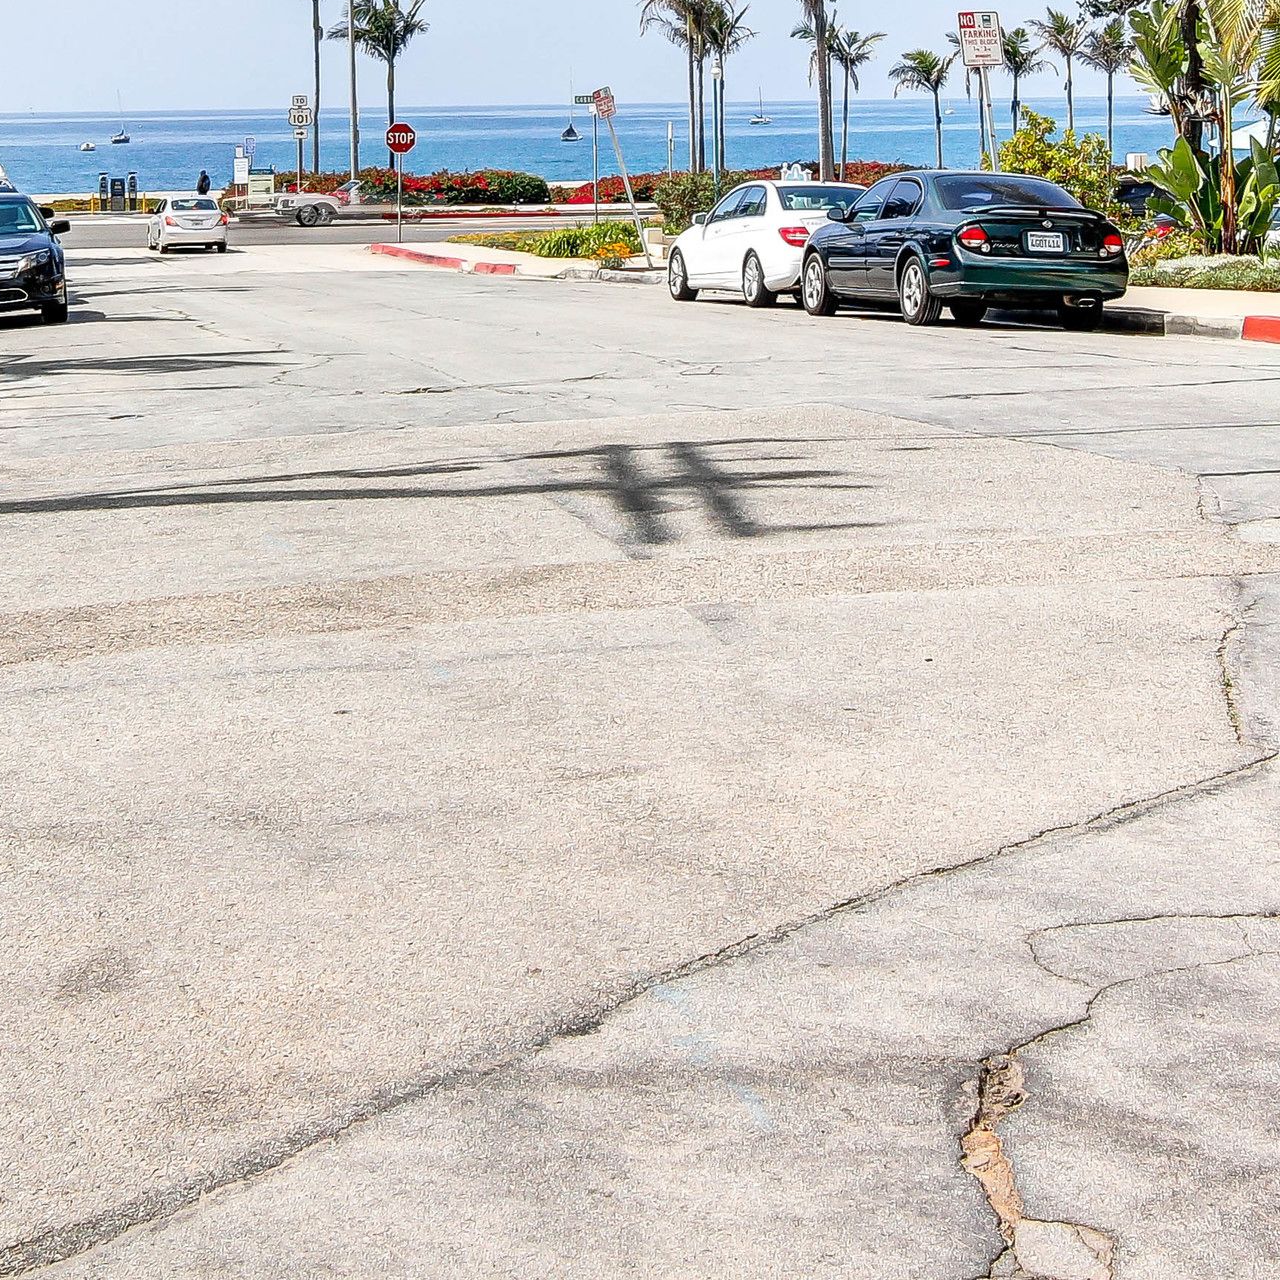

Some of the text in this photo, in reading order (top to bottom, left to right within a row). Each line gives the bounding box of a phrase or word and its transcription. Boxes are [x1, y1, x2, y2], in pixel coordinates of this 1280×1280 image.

[960, 14, 974, 26] NO
[963, 30, 997, 38] PARKING
[293, 114, 308, 124] 101
[387, 132, 414, 144] STOP
